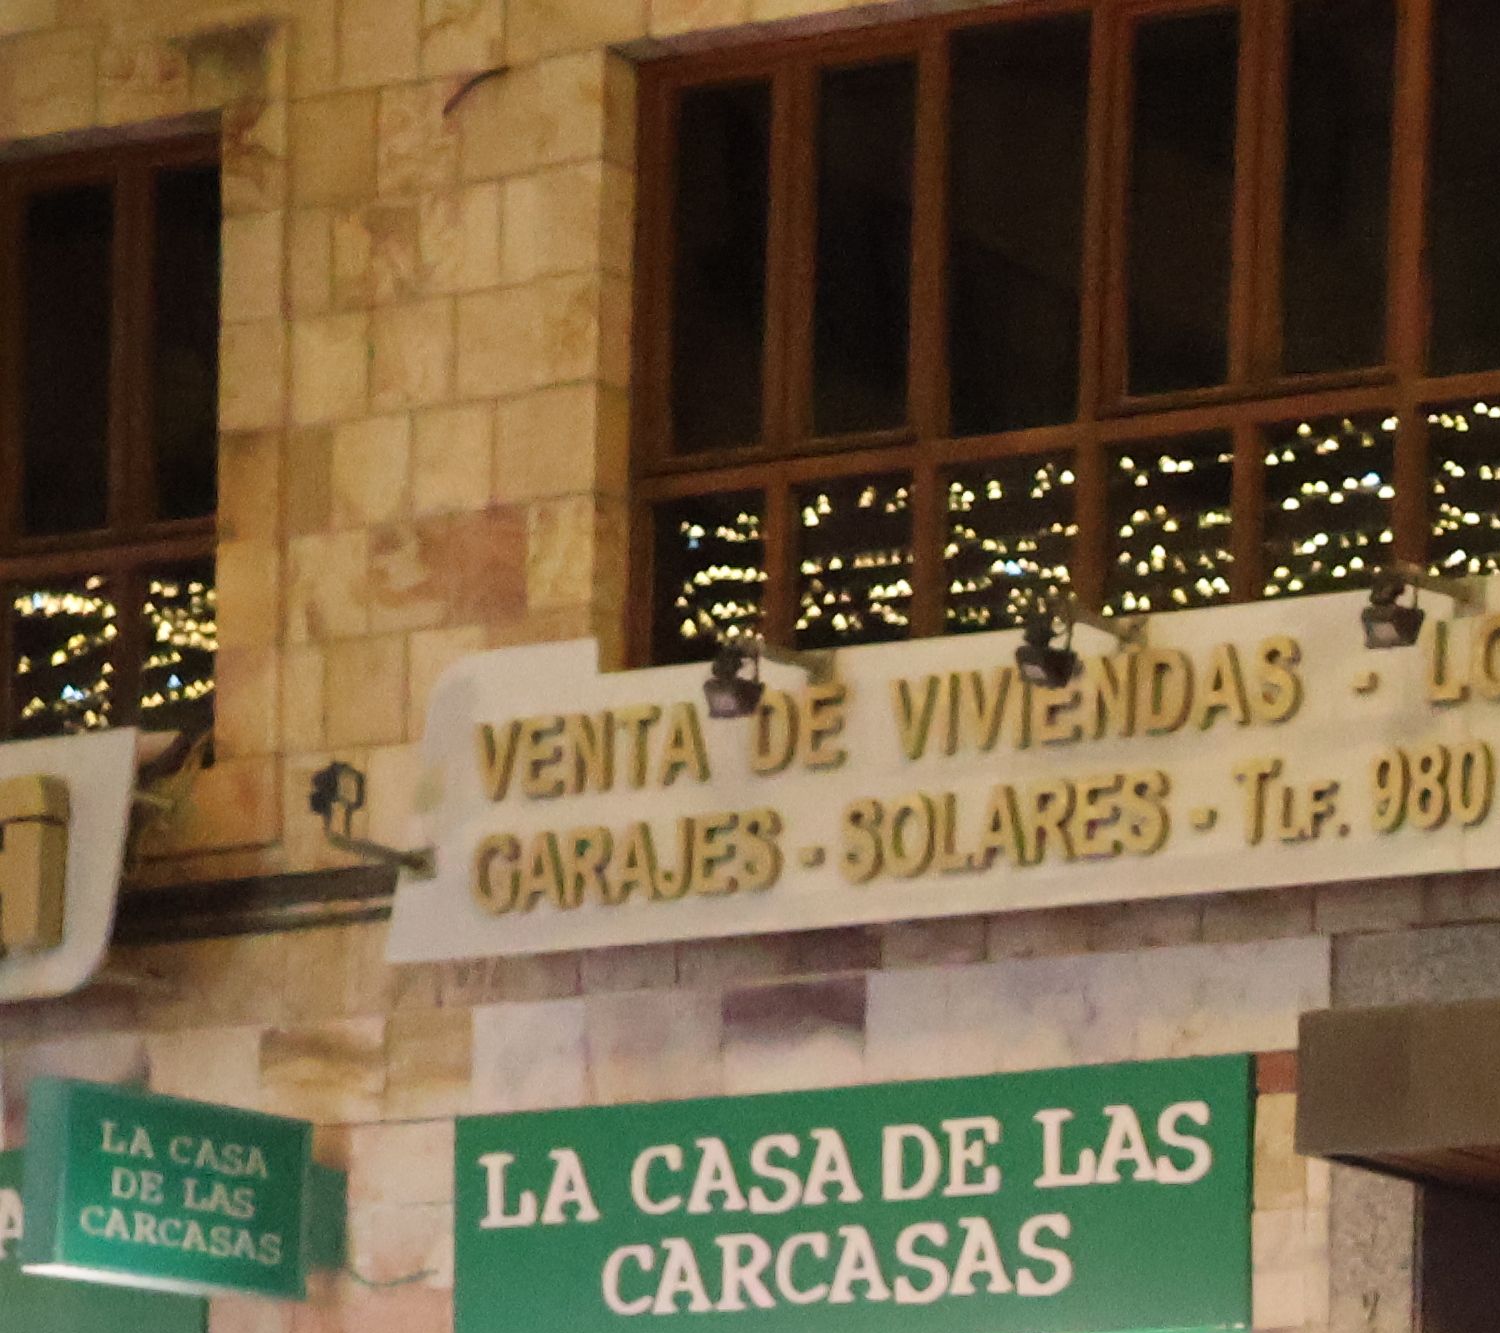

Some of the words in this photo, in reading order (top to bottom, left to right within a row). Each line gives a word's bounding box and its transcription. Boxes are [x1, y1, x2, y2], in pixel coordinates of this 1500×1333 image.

[474, 703, 711, 801] VENTA
[747, 677, 850, 777] DE
[896, 635, 1304, 760] VIVIENDAS
[470, 807, 783, 916] GARAJES
[837, 769, 1169, 884] SOLARES
[1370, 740, 1495, 834] 980
[102, 1120, 155, 1159] LA
[169, 1135, 268, 1179] CASA
[111, 1166, 165, 1205] DE
[183, 1177, 256, 1219] LAS
[478, 1148, 599, 1229] LA
[631, 1127, 862, 1216] CASA
[882, 1117, 1000, 1200] DE
[1033, 1100, 1212, 1189] LAS
[80, 1204, 283, 1265] CARCASAS
[602, 1213, 1074, 1316] CARCASAS
